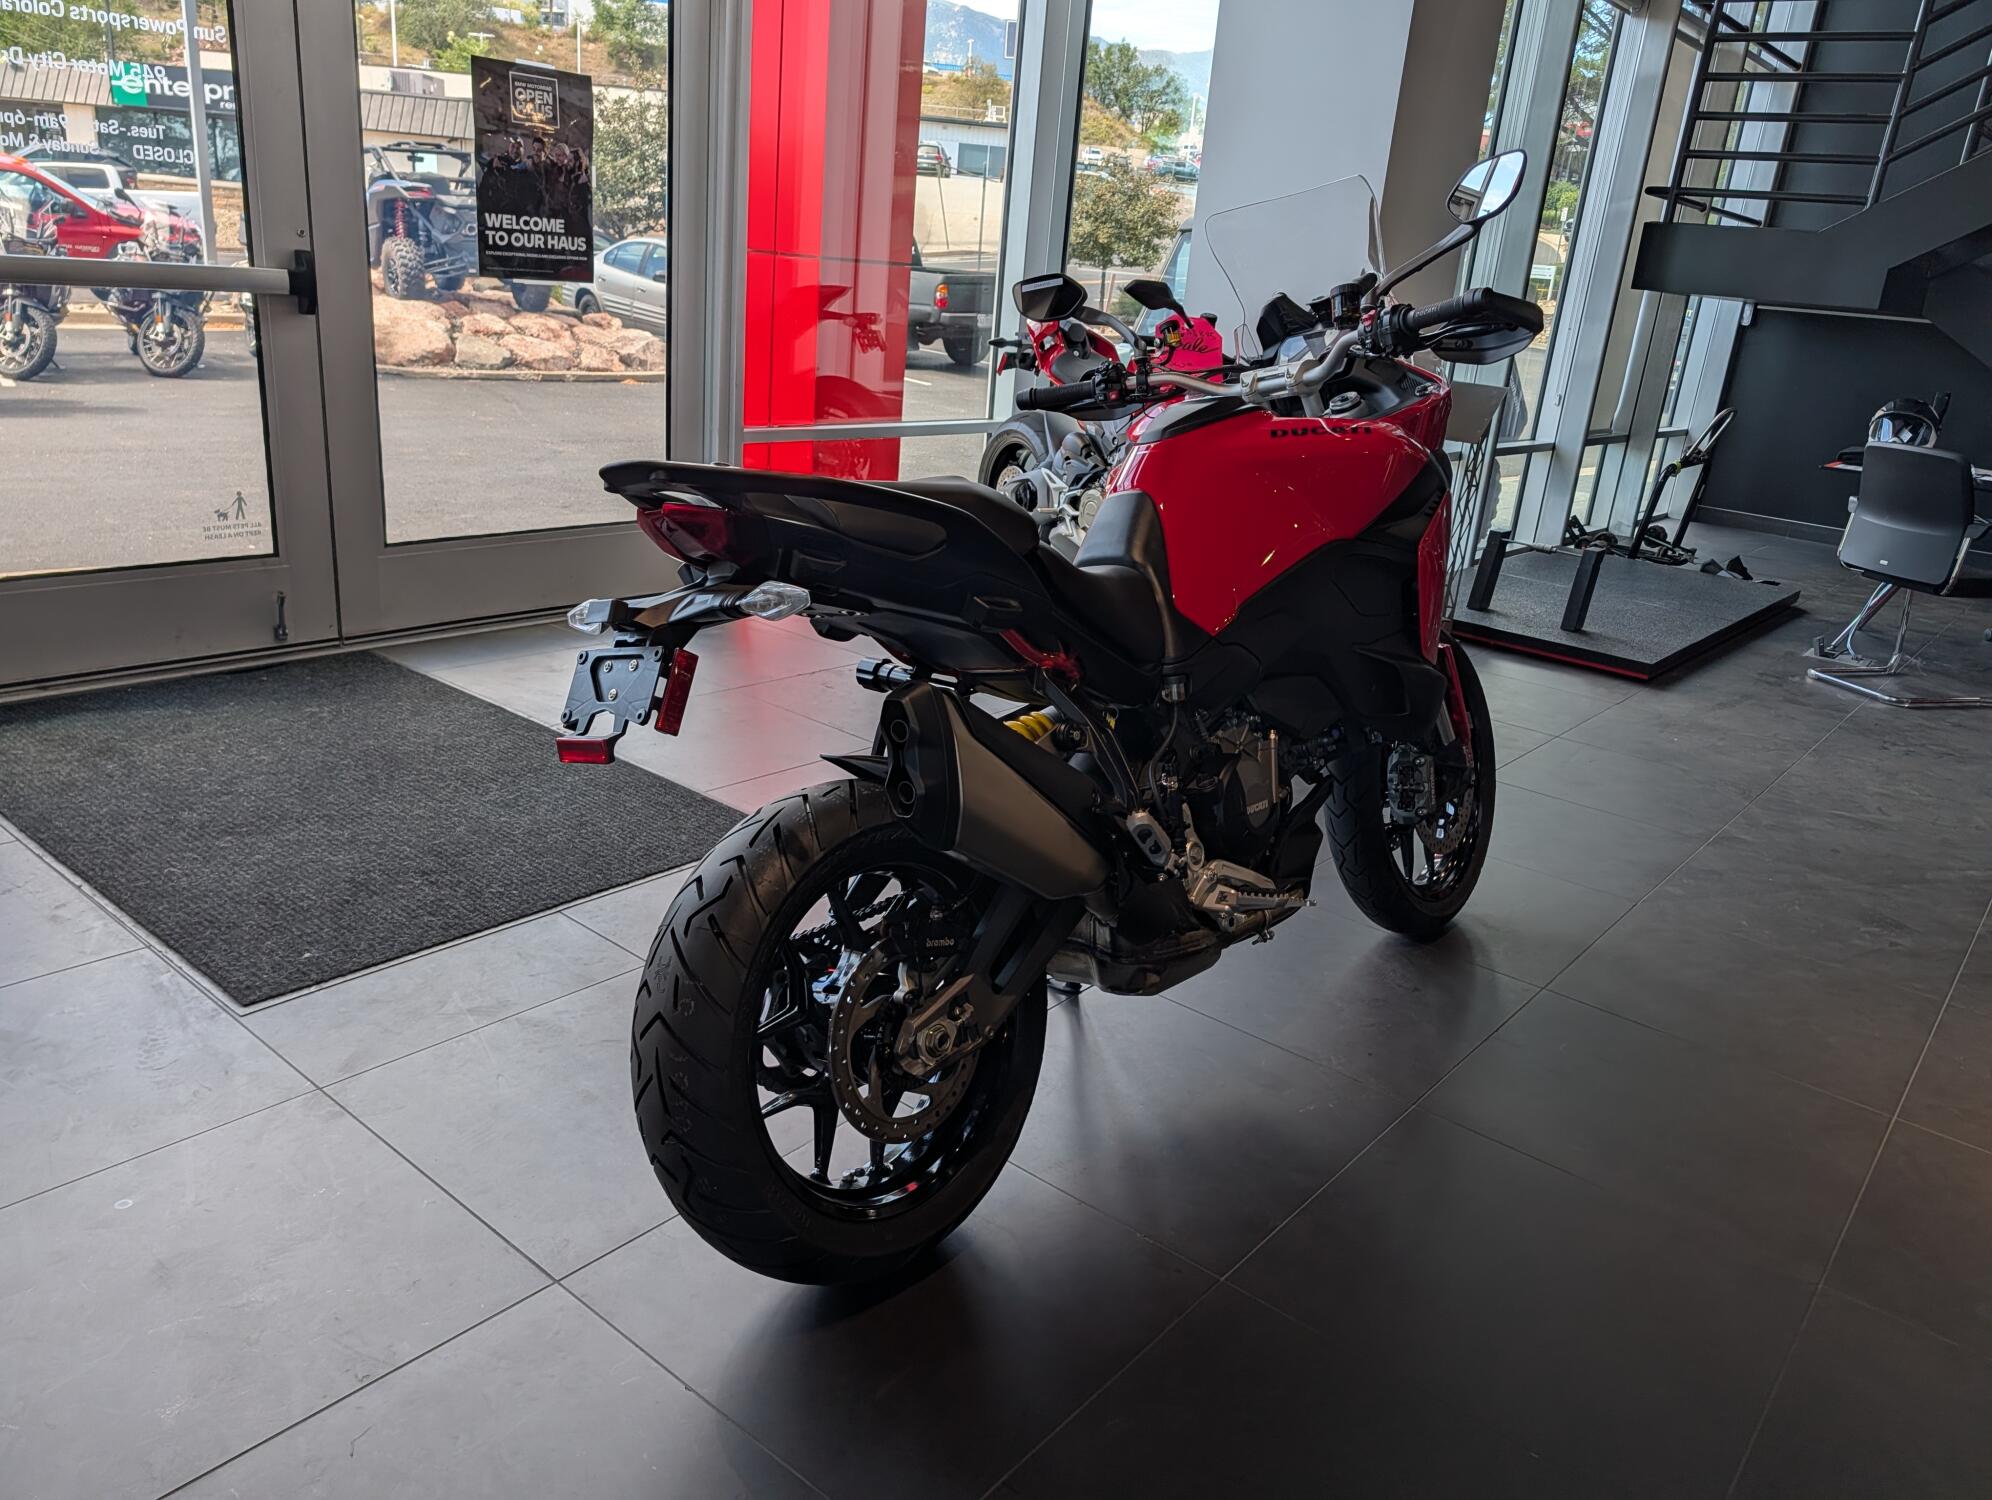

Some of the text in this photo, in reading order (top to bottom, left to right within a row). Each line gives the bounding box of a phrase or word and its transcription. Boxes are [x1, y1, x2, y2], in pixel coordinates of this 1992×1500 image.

[111, 74, 235, 104] entepr
[514, 87, 553, 105] OPEN
[485, 212, 565, 234] WELCOME
[485, 230, 587, 251] TO OUR HAUS
[1246, 800, 1269, 815] DUCATI
[925, 936, 955, 949] brembo
